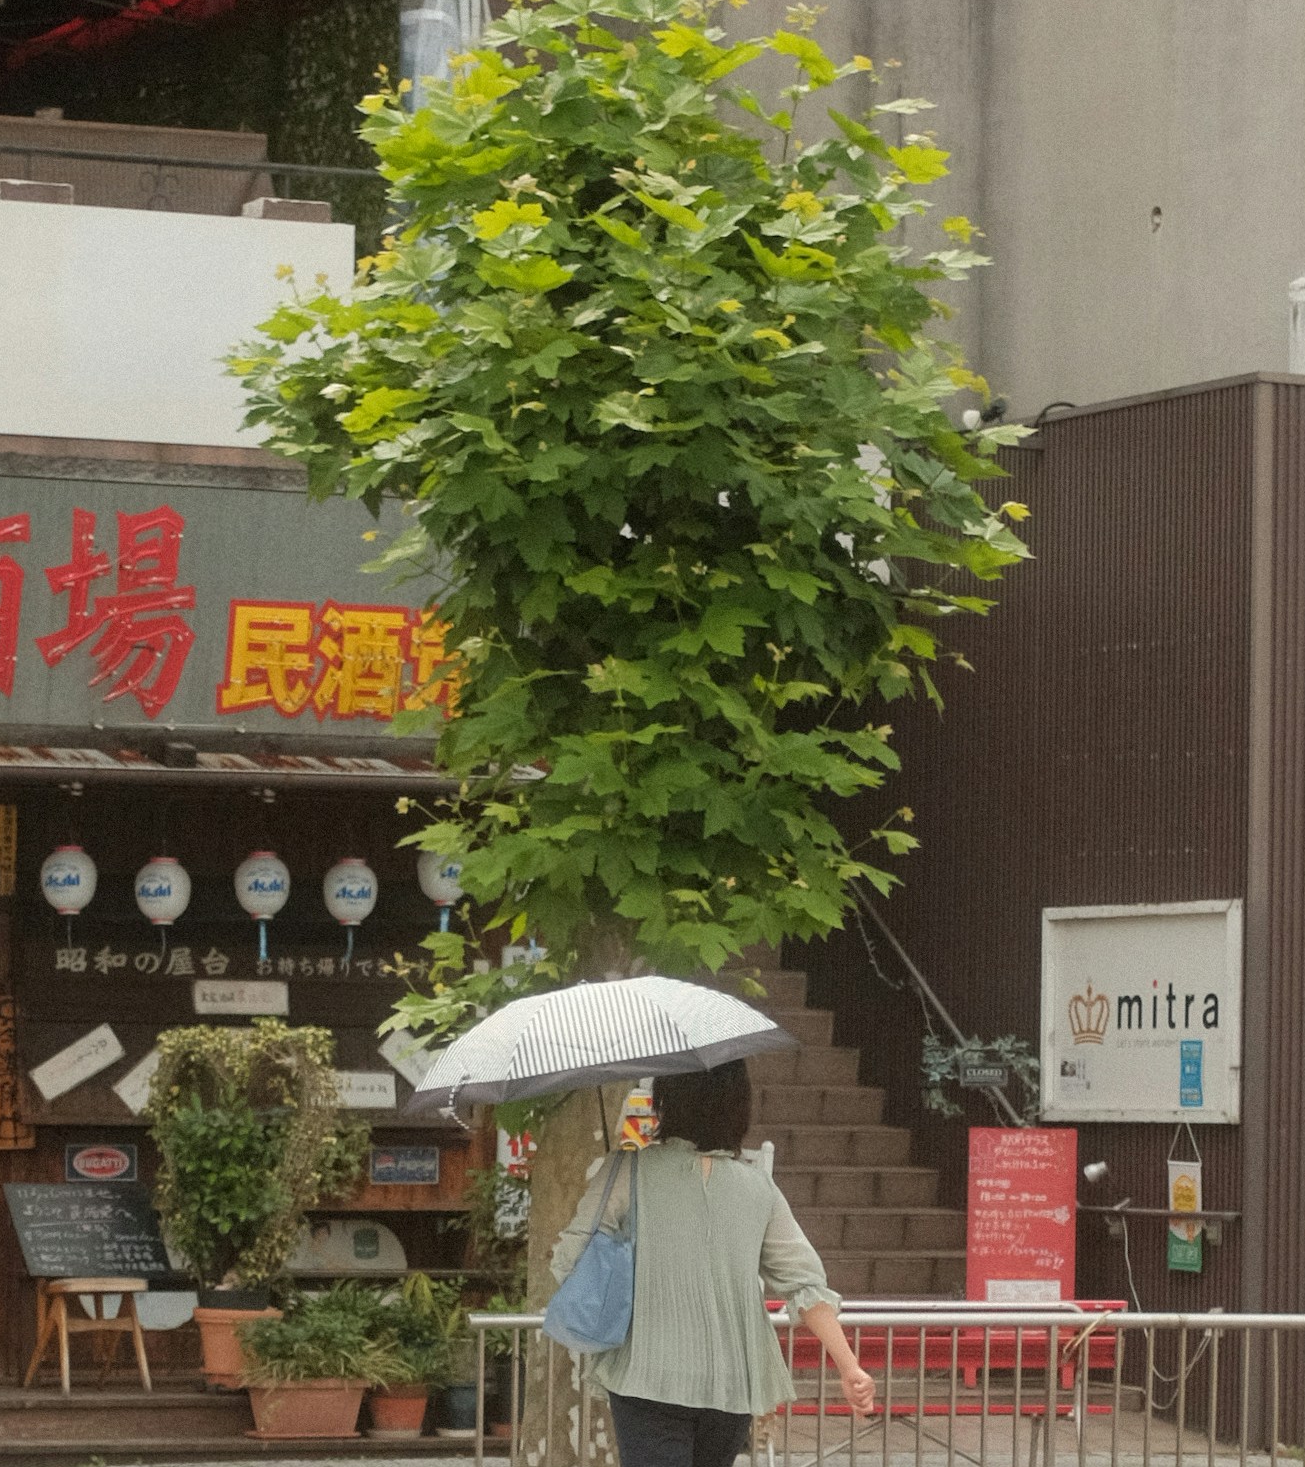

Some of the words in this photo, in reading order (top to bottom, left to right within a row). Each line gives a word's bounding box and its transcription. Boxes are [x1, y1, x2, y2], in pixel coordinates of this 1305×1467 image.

[54, 945, 230, 976] 昭和の屋台
[256, 958, 430, 978] お持ち帰りできす
[1117, 979, 1220, 1031] mitra
